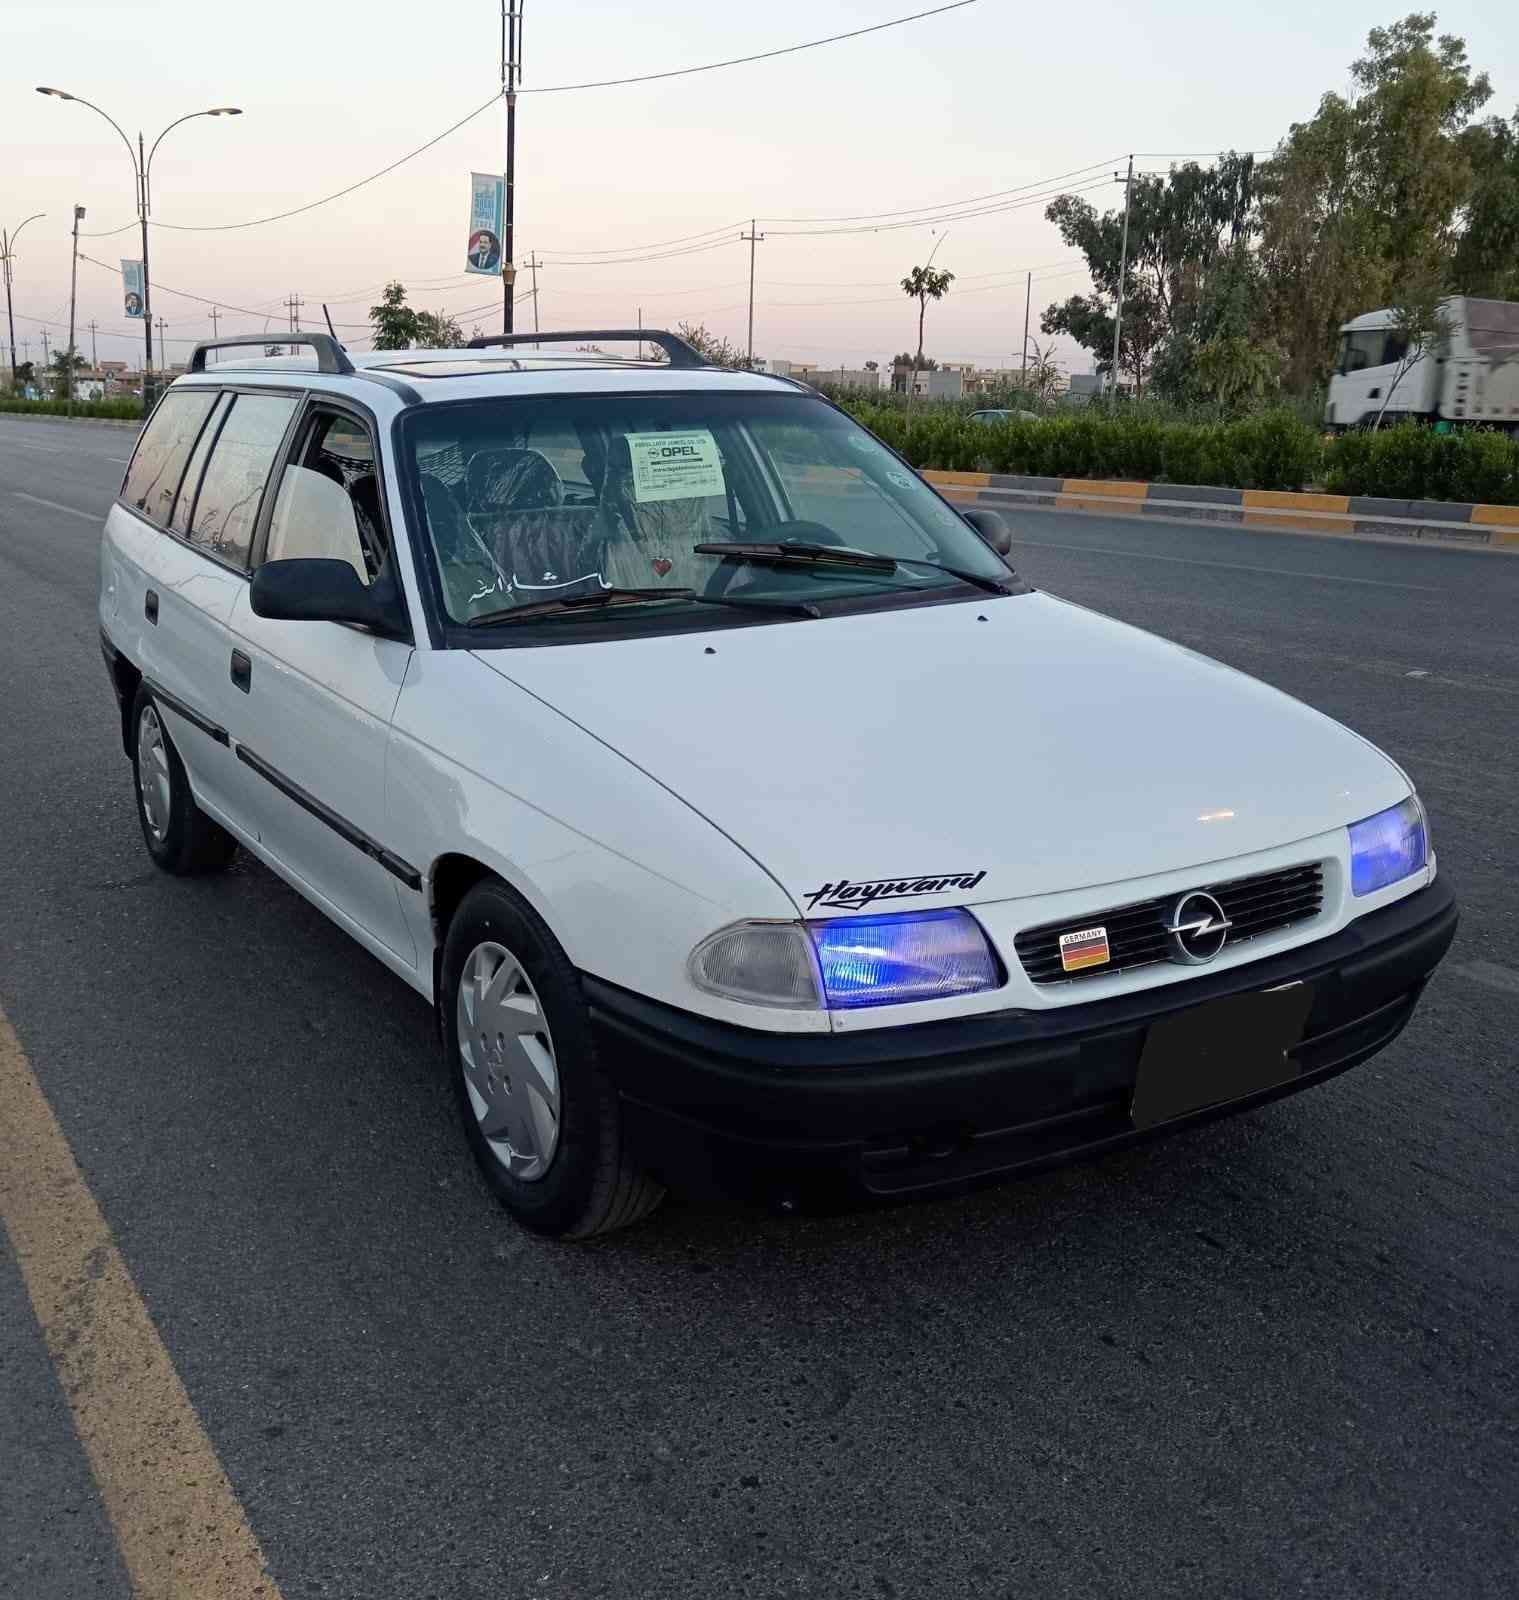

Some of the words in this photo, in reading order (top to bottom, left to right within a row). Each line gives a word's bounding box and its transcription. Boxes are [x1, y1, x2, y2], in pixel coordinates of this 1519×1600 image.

[661, 446, 700, 457] OPEL
[803, 870, 987, 911] Hayward
[1063, 929, 1102, 944] GERMANY
